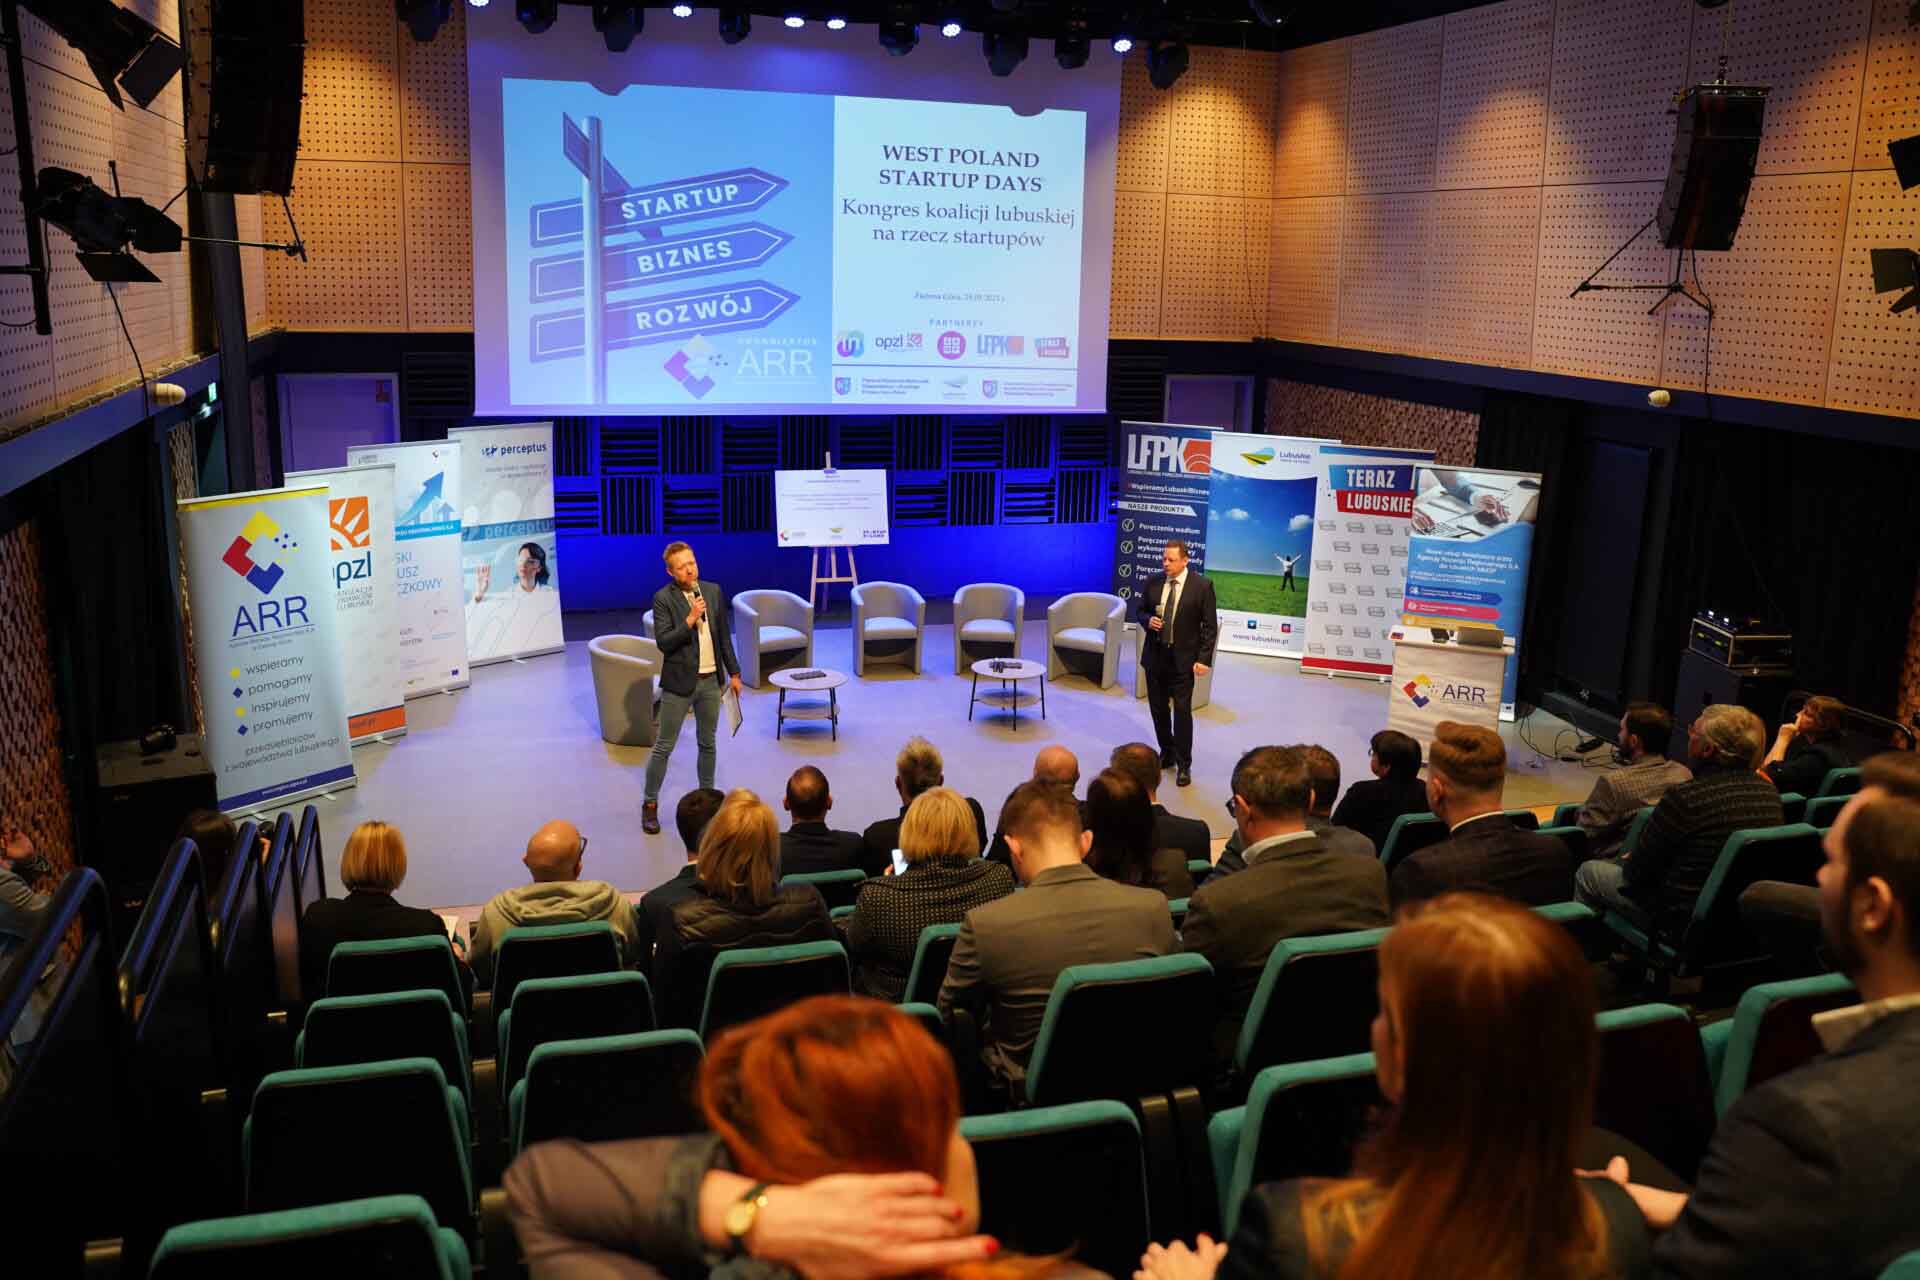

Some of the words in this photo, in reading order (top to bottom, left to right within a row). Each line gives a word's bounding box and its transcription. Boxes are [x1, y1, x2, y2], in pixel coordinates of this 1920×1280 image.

[882, 144, 944, 163] WEST
[949, 148, 1041, 169] POLAND
[879, 169, 980, 189] STARTUP
[984, 174, 1042, 193] DAYS
[621, 184, 739, 219] STARTUP
[842, 198, 920, 221] Kongres
[925, 202, 990, 224] koalicji
[995, 206, 1076, 230] lubuskiej
[872, 228, 895, 241] na
[901, 230, 949, 243] rzecz
[953, 230, 1046, 250] startupów
[637, 240, 733, 273] BIZNES
[636, 294, 753, 330] ROZWÓJ
[875, 334, 904, 349] opzl
[737, 349, 813, 376] ARR
[500, 442, 547, 456] perceptus
[1127, 434, 1186, 473] LFPK
[1346, 469, 1395, 489] TERAZ
[1346, 493, 1412, 513] LUBUSKIE
[332, 550, 372, 589] pzl
[231, 595, 310, 638] ARR
[245, 656, 305, 675] wspieramy
[248, 673, 313, 697] pomagamy
[1442, 684, 1487, 702] ARR
[251, 693, 311, 714] inspirujemy
[253, 711, 314, 734] promujemy
